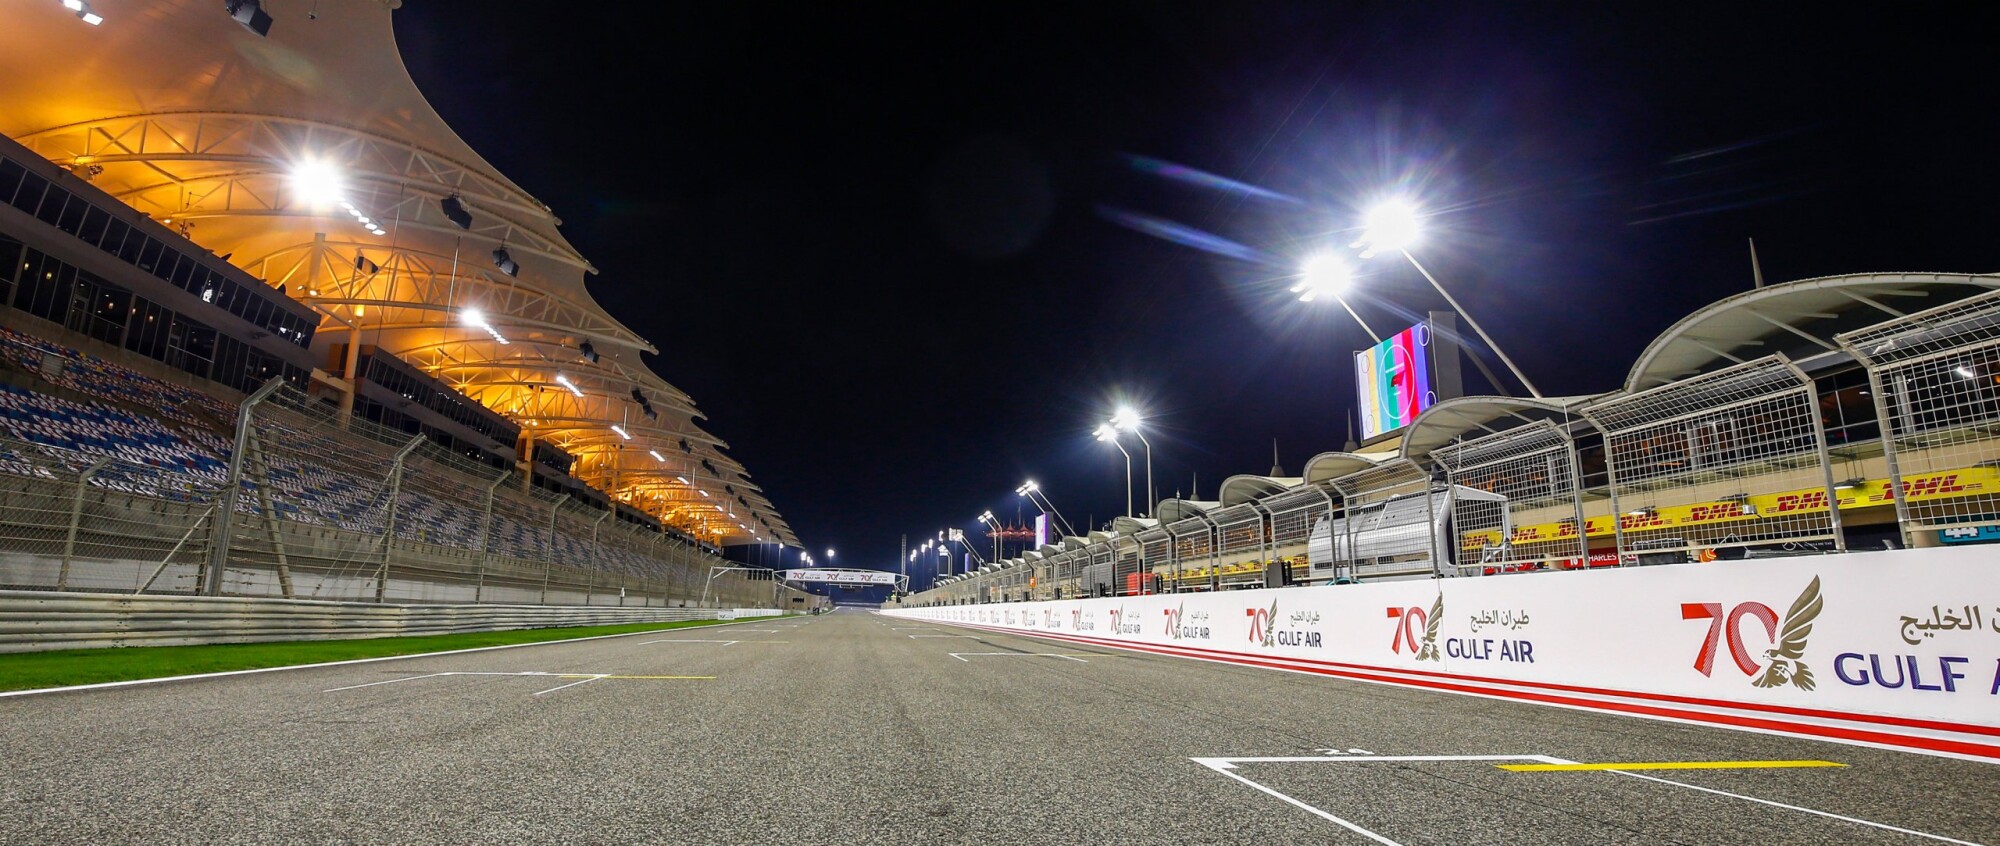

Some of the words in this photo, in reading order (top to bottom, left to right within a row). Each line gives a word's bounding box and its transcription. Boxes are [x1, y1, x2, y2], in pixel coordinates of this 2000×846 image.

[1883, 475, 1965, 500] DHL
[1620, 512, 1664, 529] DHL
[1691, 502, 1744, 521] DHL
[1588, 552, 1618, 563] HARLES
[1164, 609, 1178, 636] 70
[1246, 608, 1269, 643] 70
[1387, 606, 1427, 655] 70
[1470, 609, 1499, 633] الخليج
[1501, 609, 1530, 631] طيران
[1899, 604, 1983, 645] الخليج
[1183, 626, 1198, 639] GULF
[1199, 627, 1210, 640] AIR
[1278, 630, 1302, 646] GULF
[1304, 631, 1322, 648] AIR
[1681, 601, 1779, 678] 70
[1446, 638, 1494, 660] GULF
[1500, 639, 1535, 664] AIR
[1833, 652, 1969, 693] GULF
